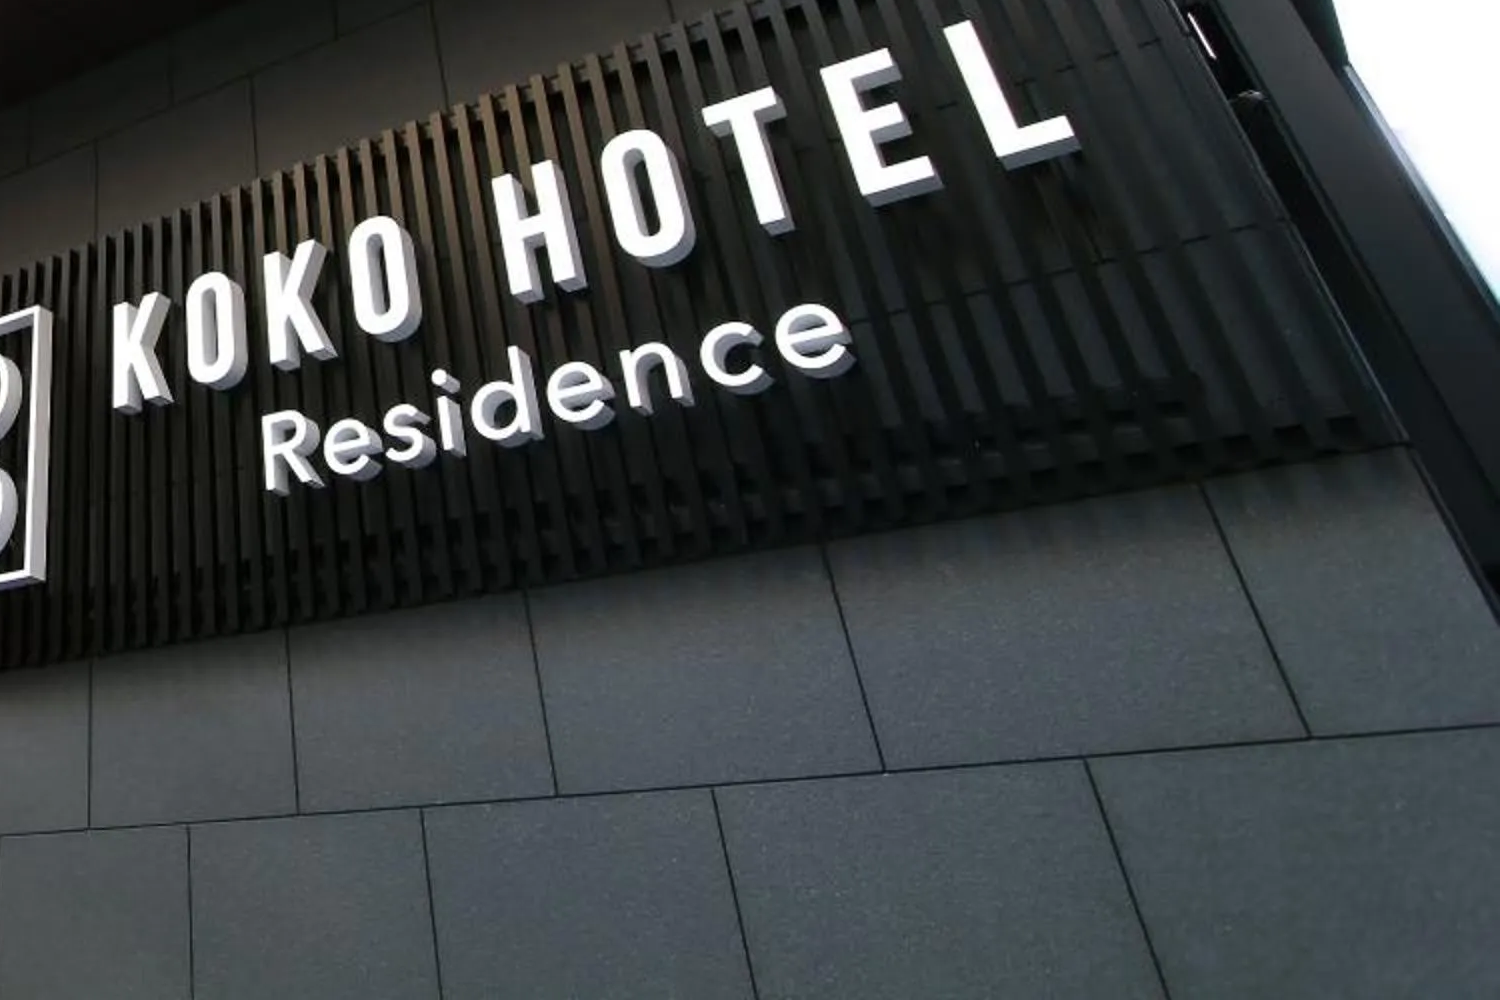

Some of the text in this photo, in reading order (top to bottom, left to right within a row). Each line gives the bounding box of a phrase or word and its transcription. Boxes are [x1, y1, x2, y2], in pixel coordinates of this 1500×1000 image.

[111, 19, 1082, 415] KOKO HOTEL
[260, 300, 857, 495] Residence
